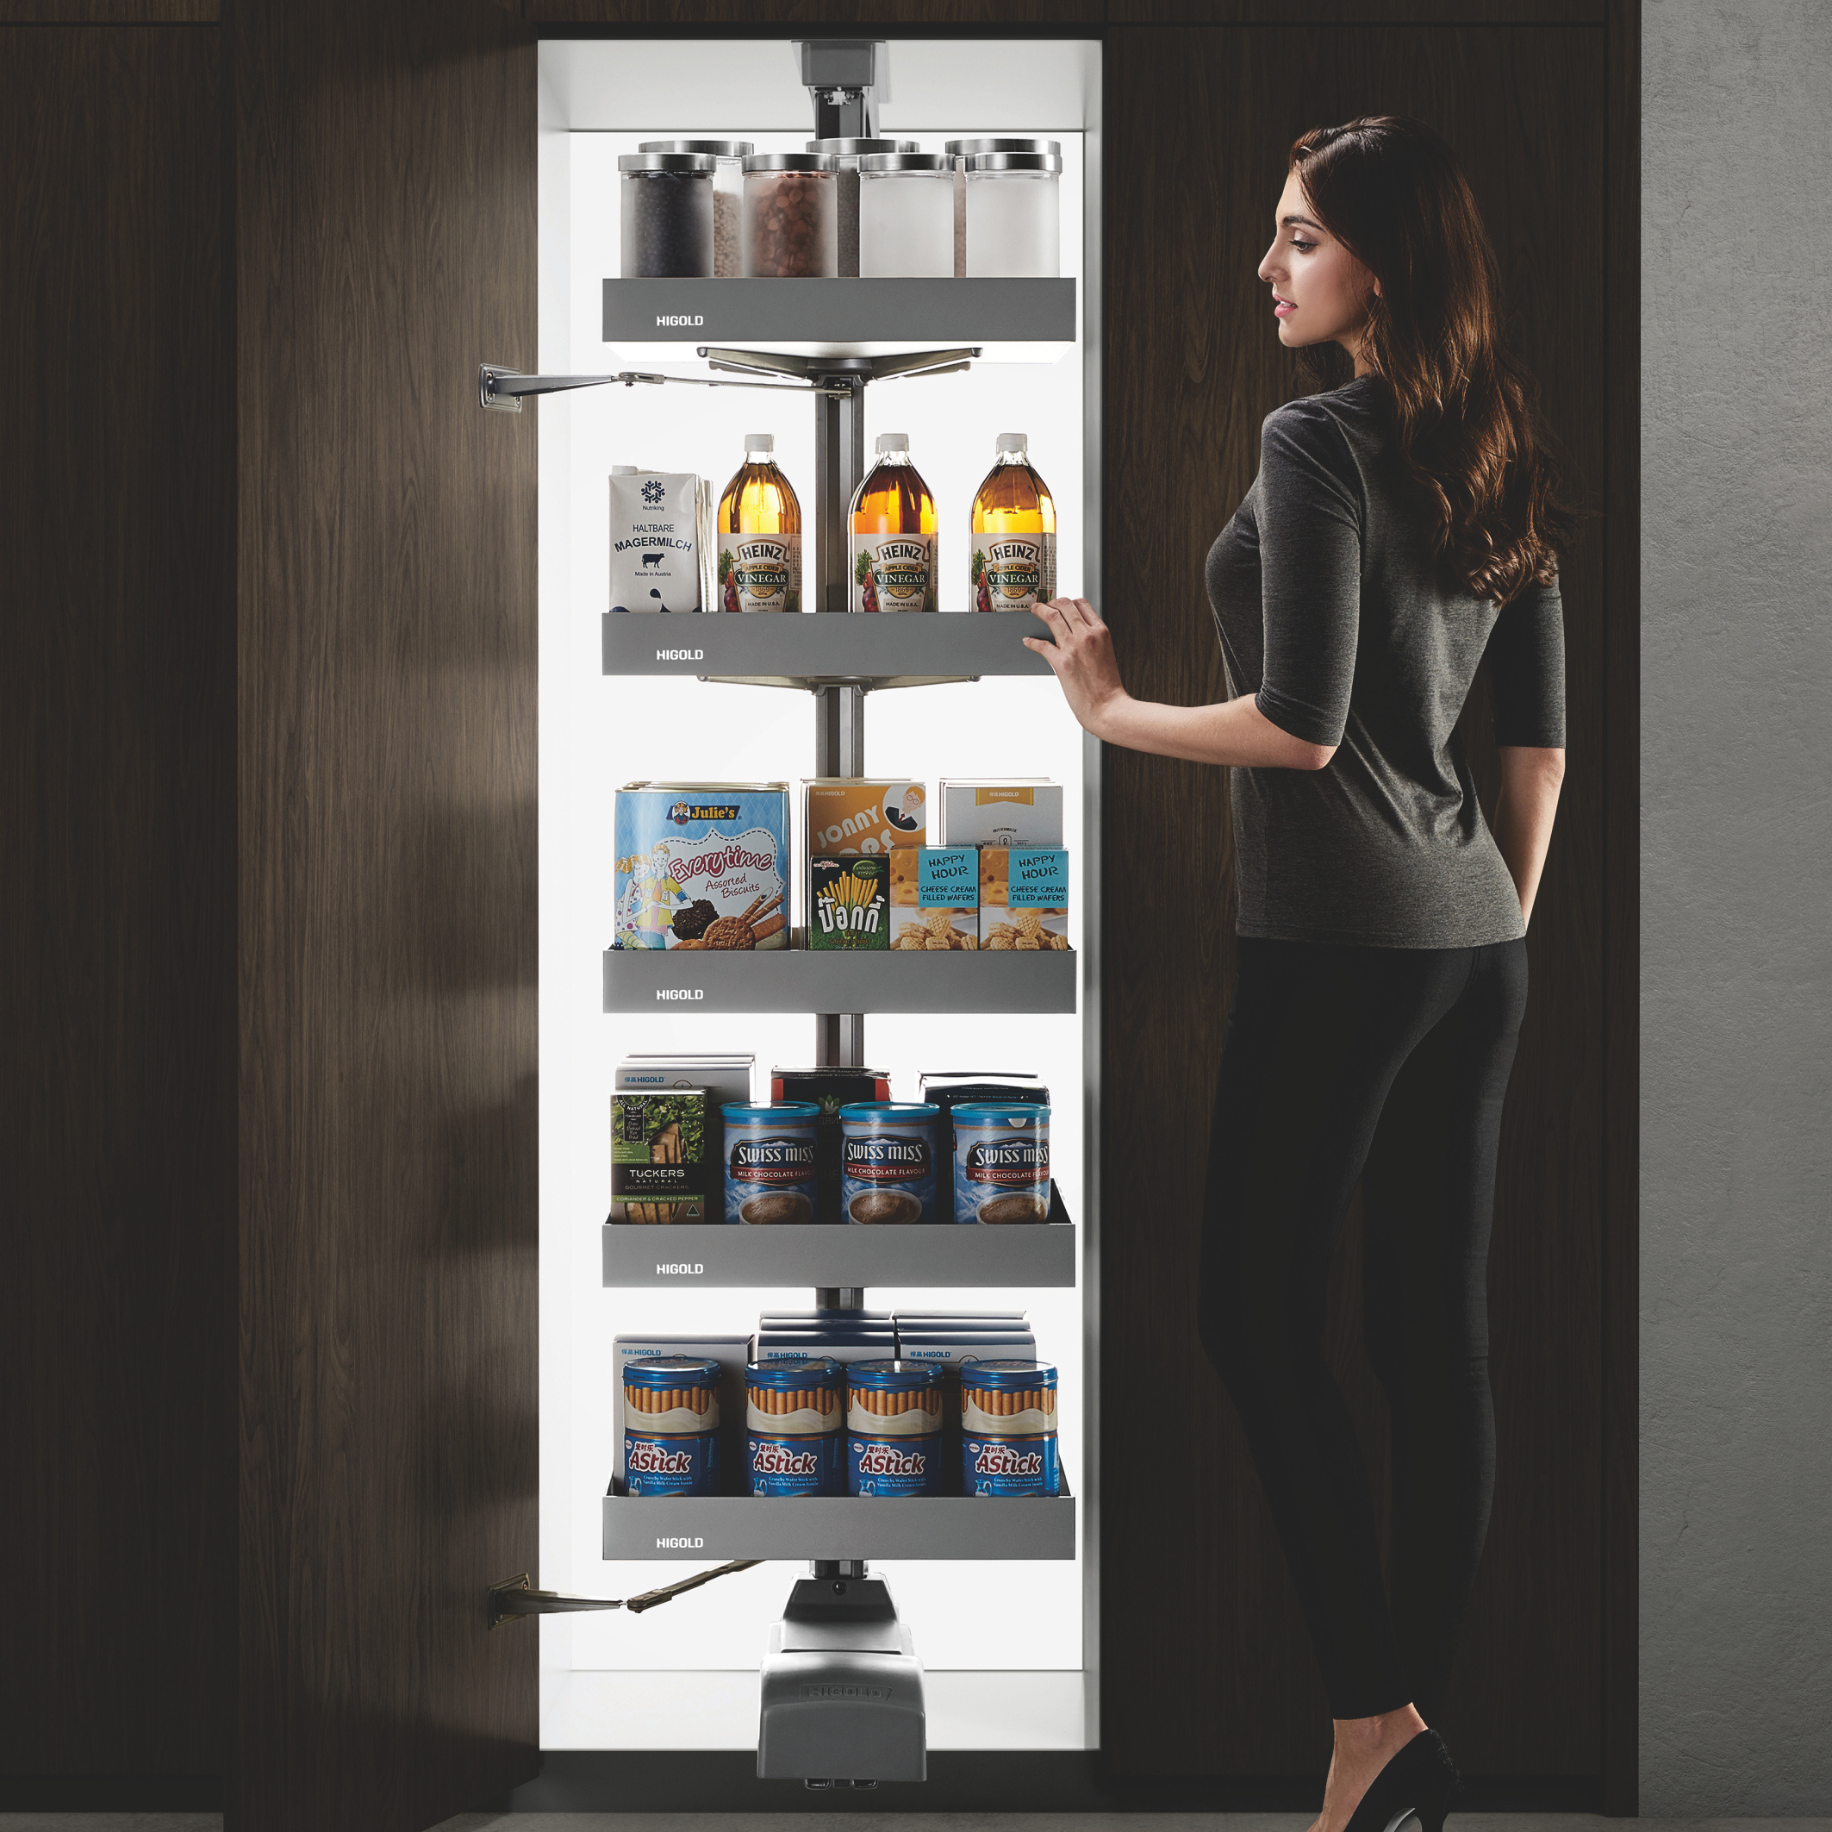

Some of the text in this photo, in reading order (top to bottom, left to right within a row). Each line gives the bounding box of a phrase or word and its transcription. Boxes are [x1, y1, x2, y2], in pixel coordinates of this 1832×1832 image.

[656, 315, 704, 326] HIGOLD
[632, 524, 675, 533] HALTBARE
[614, 537, 692, 552] MAGERMILCH
[741, 544, 782, 561] HEINZ
[881, 544, 922, 561] HEINZ
[993, 544, 1035, 561] HEINZ
[737, 574, 787, 583] VINEGAR
[876, 574, 926, 583] VINEGAR
[989, 574, 1039, 583] VINEGAR
[656, 649, 704, 661] HIGOLD
[692, 808, 735, 819] Julie's
[817, 805, 880, 849] JONNY
[668, 845, 773, 884] Everytime
[928, 854, 965, 867] HAPPY
[1018, 854, 1055, 867] HAPPY
[931, 866, 969, 880] HOUR
[1021, 866, 1059, 880] HOUR
[705, 873, 747, 891] Assorted
[721, 883, 760, 898] Biscuits
[656, 989, 704, 1000] HIGOLD
[738, 1146, 782, 1165] SWISS
[847, 1142, 884, 1160] SWISS
[975, 1147, 1020, 1166] SWISS
[629, 1169, 685, 1178] TUCKERS
[991, 1171, 1032, 1179] CHOCOLATE
[656, 1263, 704, 1275] HIGOLD
[629, 1449, 691, 1472] AStick
[753, 1450, 817, 1473] AStick
[860, 1451, 925, 1474] AStick
[976, 1451, 1041, 1474] AStick
[656, 1537, 704, 1549] HIGOLD
[808, 1685, 882, 1698] HIGOLD
